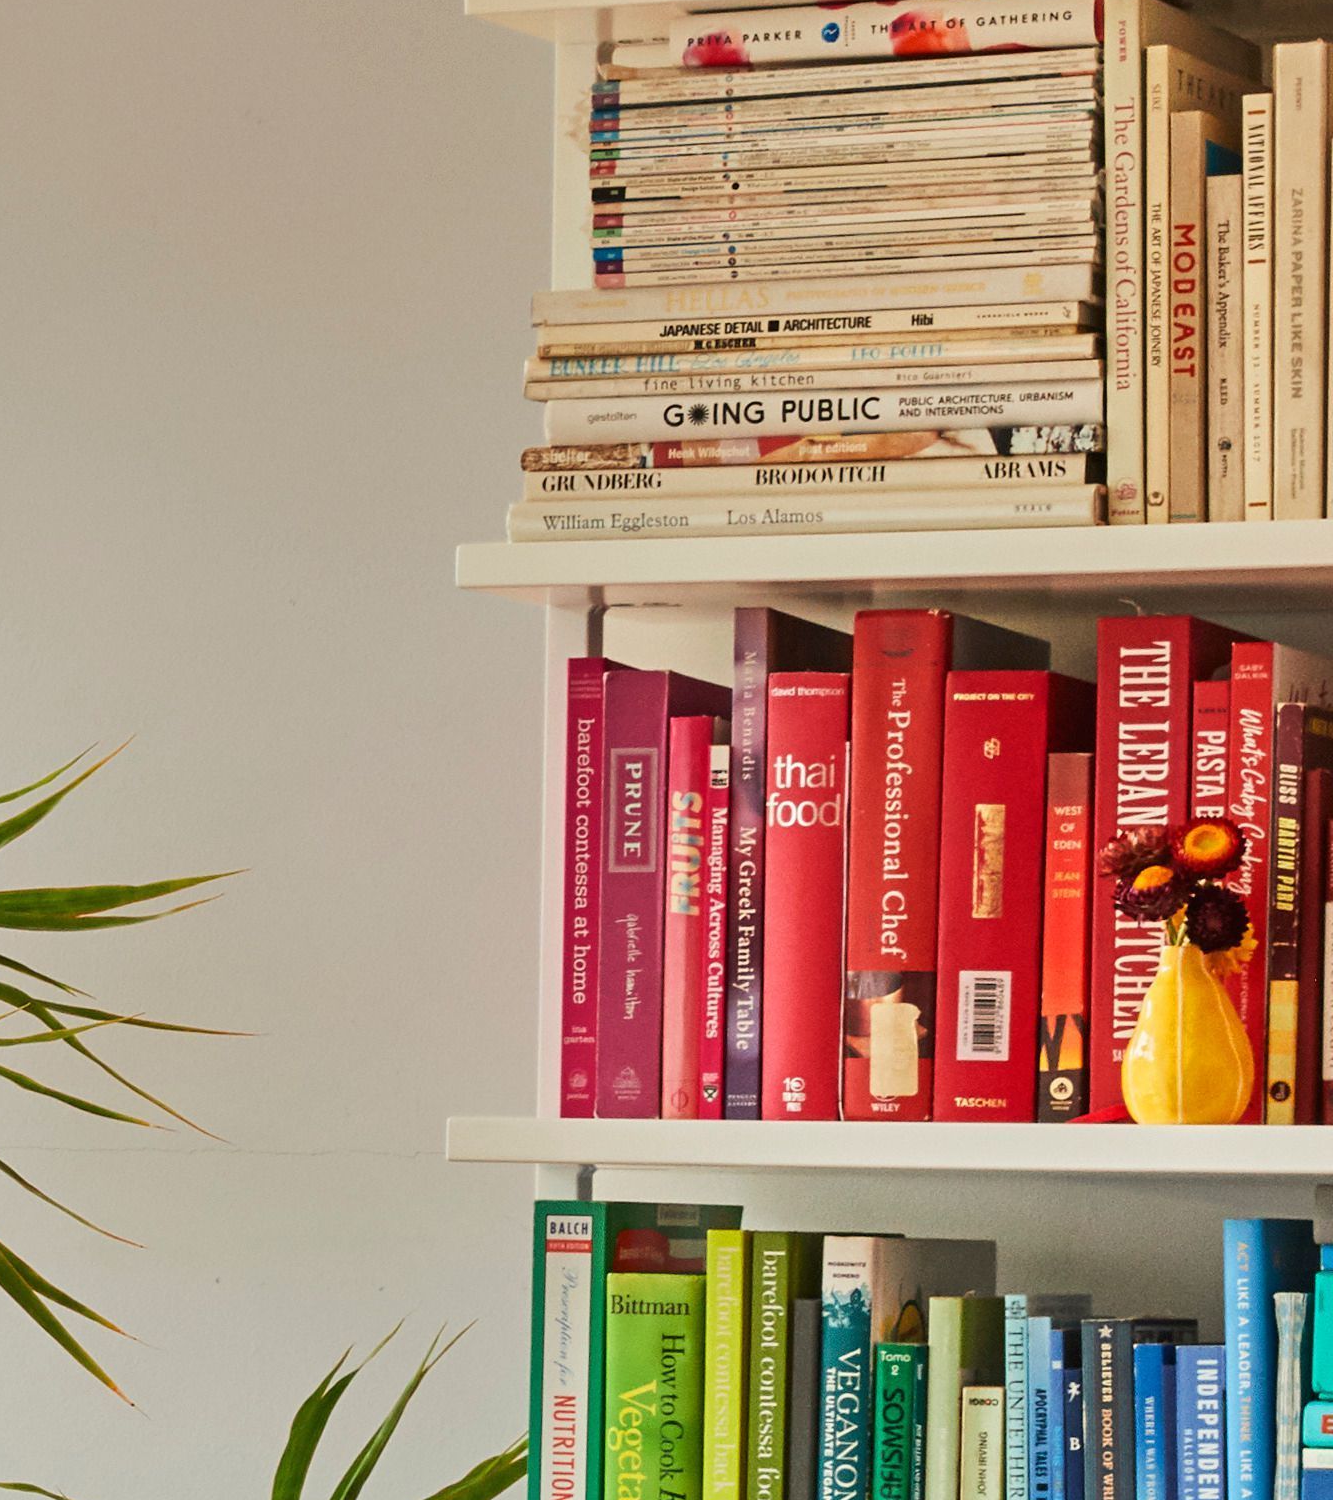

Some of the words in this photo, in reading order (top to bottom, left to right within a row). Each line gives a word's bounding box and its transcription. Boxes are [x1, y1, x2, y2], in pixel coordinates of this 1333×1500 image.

[687, 32, 732, 48] PRIYA
[743, 29, 802, 44] PARKER
[871, 22, 899, 34] THE
[908, 21, 936, 31] ART
[947, 18, 966, 29] OF
[976, 11, 1073, 27] GATHERING
[1114, 97, 1134, 146] The
[1113, 152, 1135, 248] Gardens
[1114, 250, 1135, 274] of
[660, 323, 721, 337] JAPANESE
[725, 321, 763, 334] DETAIL
[783, 315, 872, 331] ARCHITECTURE
[912, 314, 933, 326] Hibi
[1114, 279, 1135, 390] California
[782, 397, 880, 424] PUBLIC
[899, 397, 933, 406] PUBLIC
[939, 394, 1015, 404] ARCHITECTURE,
[1019, 391, 1073, 401] URBANISM
[899, 407, 921, 417] AND
[925, 405, 1004, 416] INTERVENTIONS
[542, 473, 661, 492] GRUNDBERG
[756, 466, 886, 486] BRODOVITCH
[983, 460, 1066, 480] ABRAMS
[543, 514, 605, 530] William
[611, 513, 689, 532] Eggleston
[728, 510, 757, 525] Los
[761, 508, 823, 525] Alamos
[1119, 641, 1172, 708] THE
[891, 679, 906, 706] The
[576, 719, 596, 807] barefoot
[774, 756, 835, 789] thai
[1117, 722, 1168, 825] LEBAN
[1196, 731, 1226, 798] PASTA
[624, 763, 642, 858] PRUNE
[767, 795, 839, 827] food
[882, 710, 911, 880] Professional
[1055, 806, 1083, 816] WEST
[736, 827, 755, 856] My
[1060, 822, 1075, 832] OF
[707, 807, 726, 893] Managing
[1054, 840, 1081, 850] EDEN
[574, 814, 590, 909] contessa
[738, 861, 756, 920] Greek
[574, 916, 588, 938] at
[708, 898, 724, 958] Across
[880, 890, 908, 956] Chef
[734, 925, 755, 991] Family
[573, 945, 592, 1004] home
[1112, 909, 1158, 1040] ITCHEN
[705, 963, 723, 1038] Cultures
[735, 996, 753, 1049] Table
[871, 1101, 900, 1113] WILEY
[955, 1097, 1006, 1108] TASCHEN
[549, 1220, 589, 1236] BALCH
[610, 1294, 691, 1316] Bittman
[760, 1251, 784, 1348] barefoot
[660, 1334, 687, 1386] How
[825, 1367, 837, 1388] THE
[660, 1394, 682, 1416] to
[758, 1357, 778, 1459] contessa
[823, 1393, 836, 1457] ULTIMATE
[659, 1420, 684, 1480] Cook
